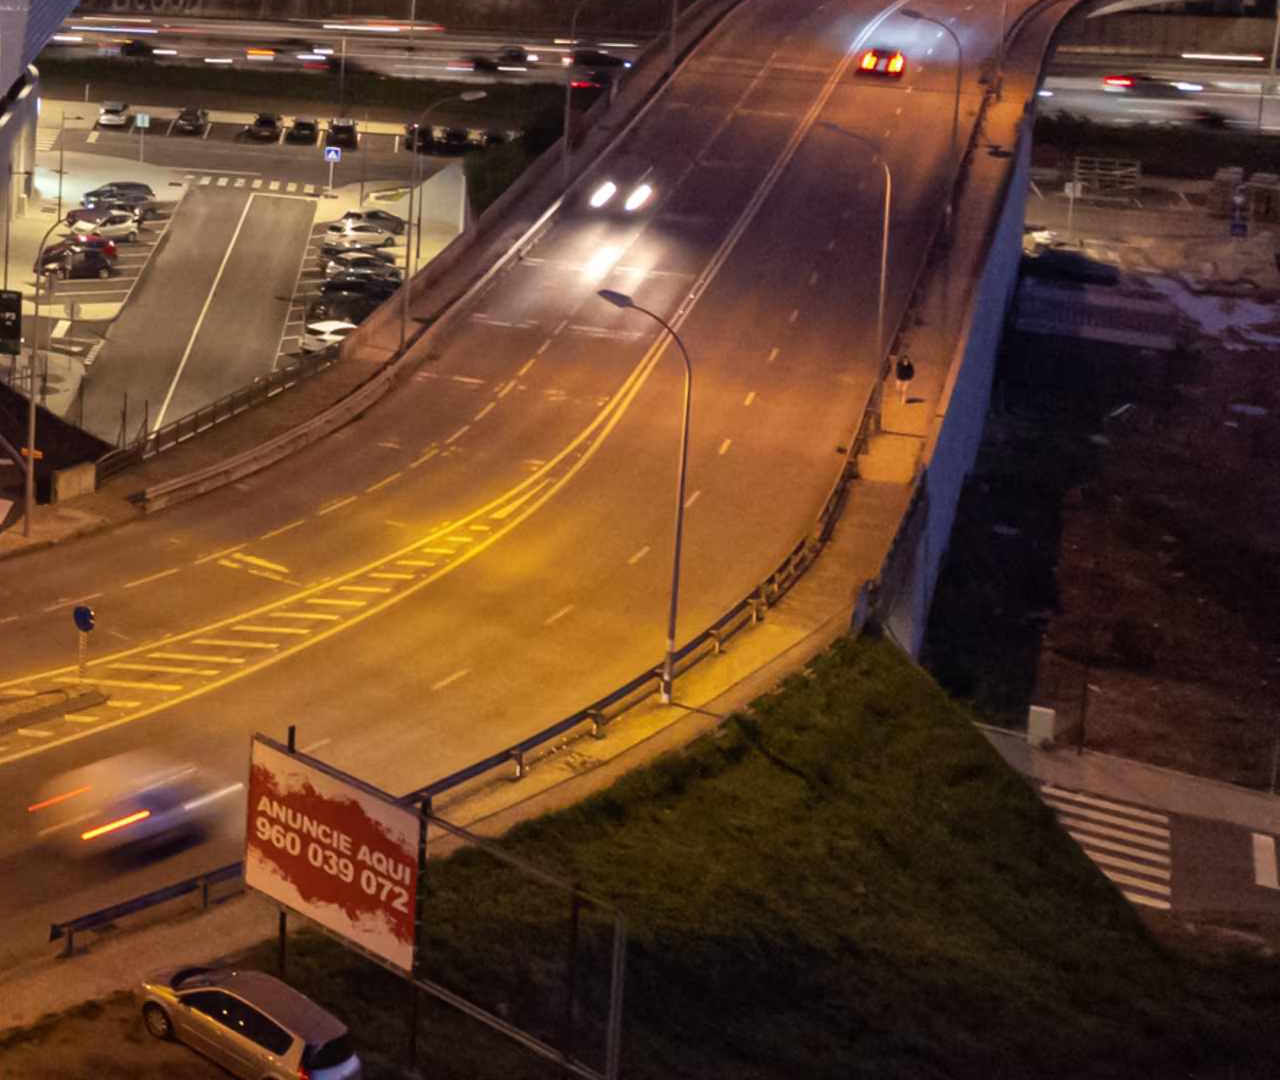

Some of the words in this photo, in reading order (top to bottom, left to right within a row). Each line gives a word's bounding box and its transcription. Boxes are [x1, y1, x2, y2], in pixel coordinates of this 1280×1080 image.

[256, 795, 353, 856] ANUNCIE
[357, 844, 411, 886] AQUI
[256, 816, 301, 856] 960
[308, 842, 355, 883] 039
[361, 869, 410, 915] 072
